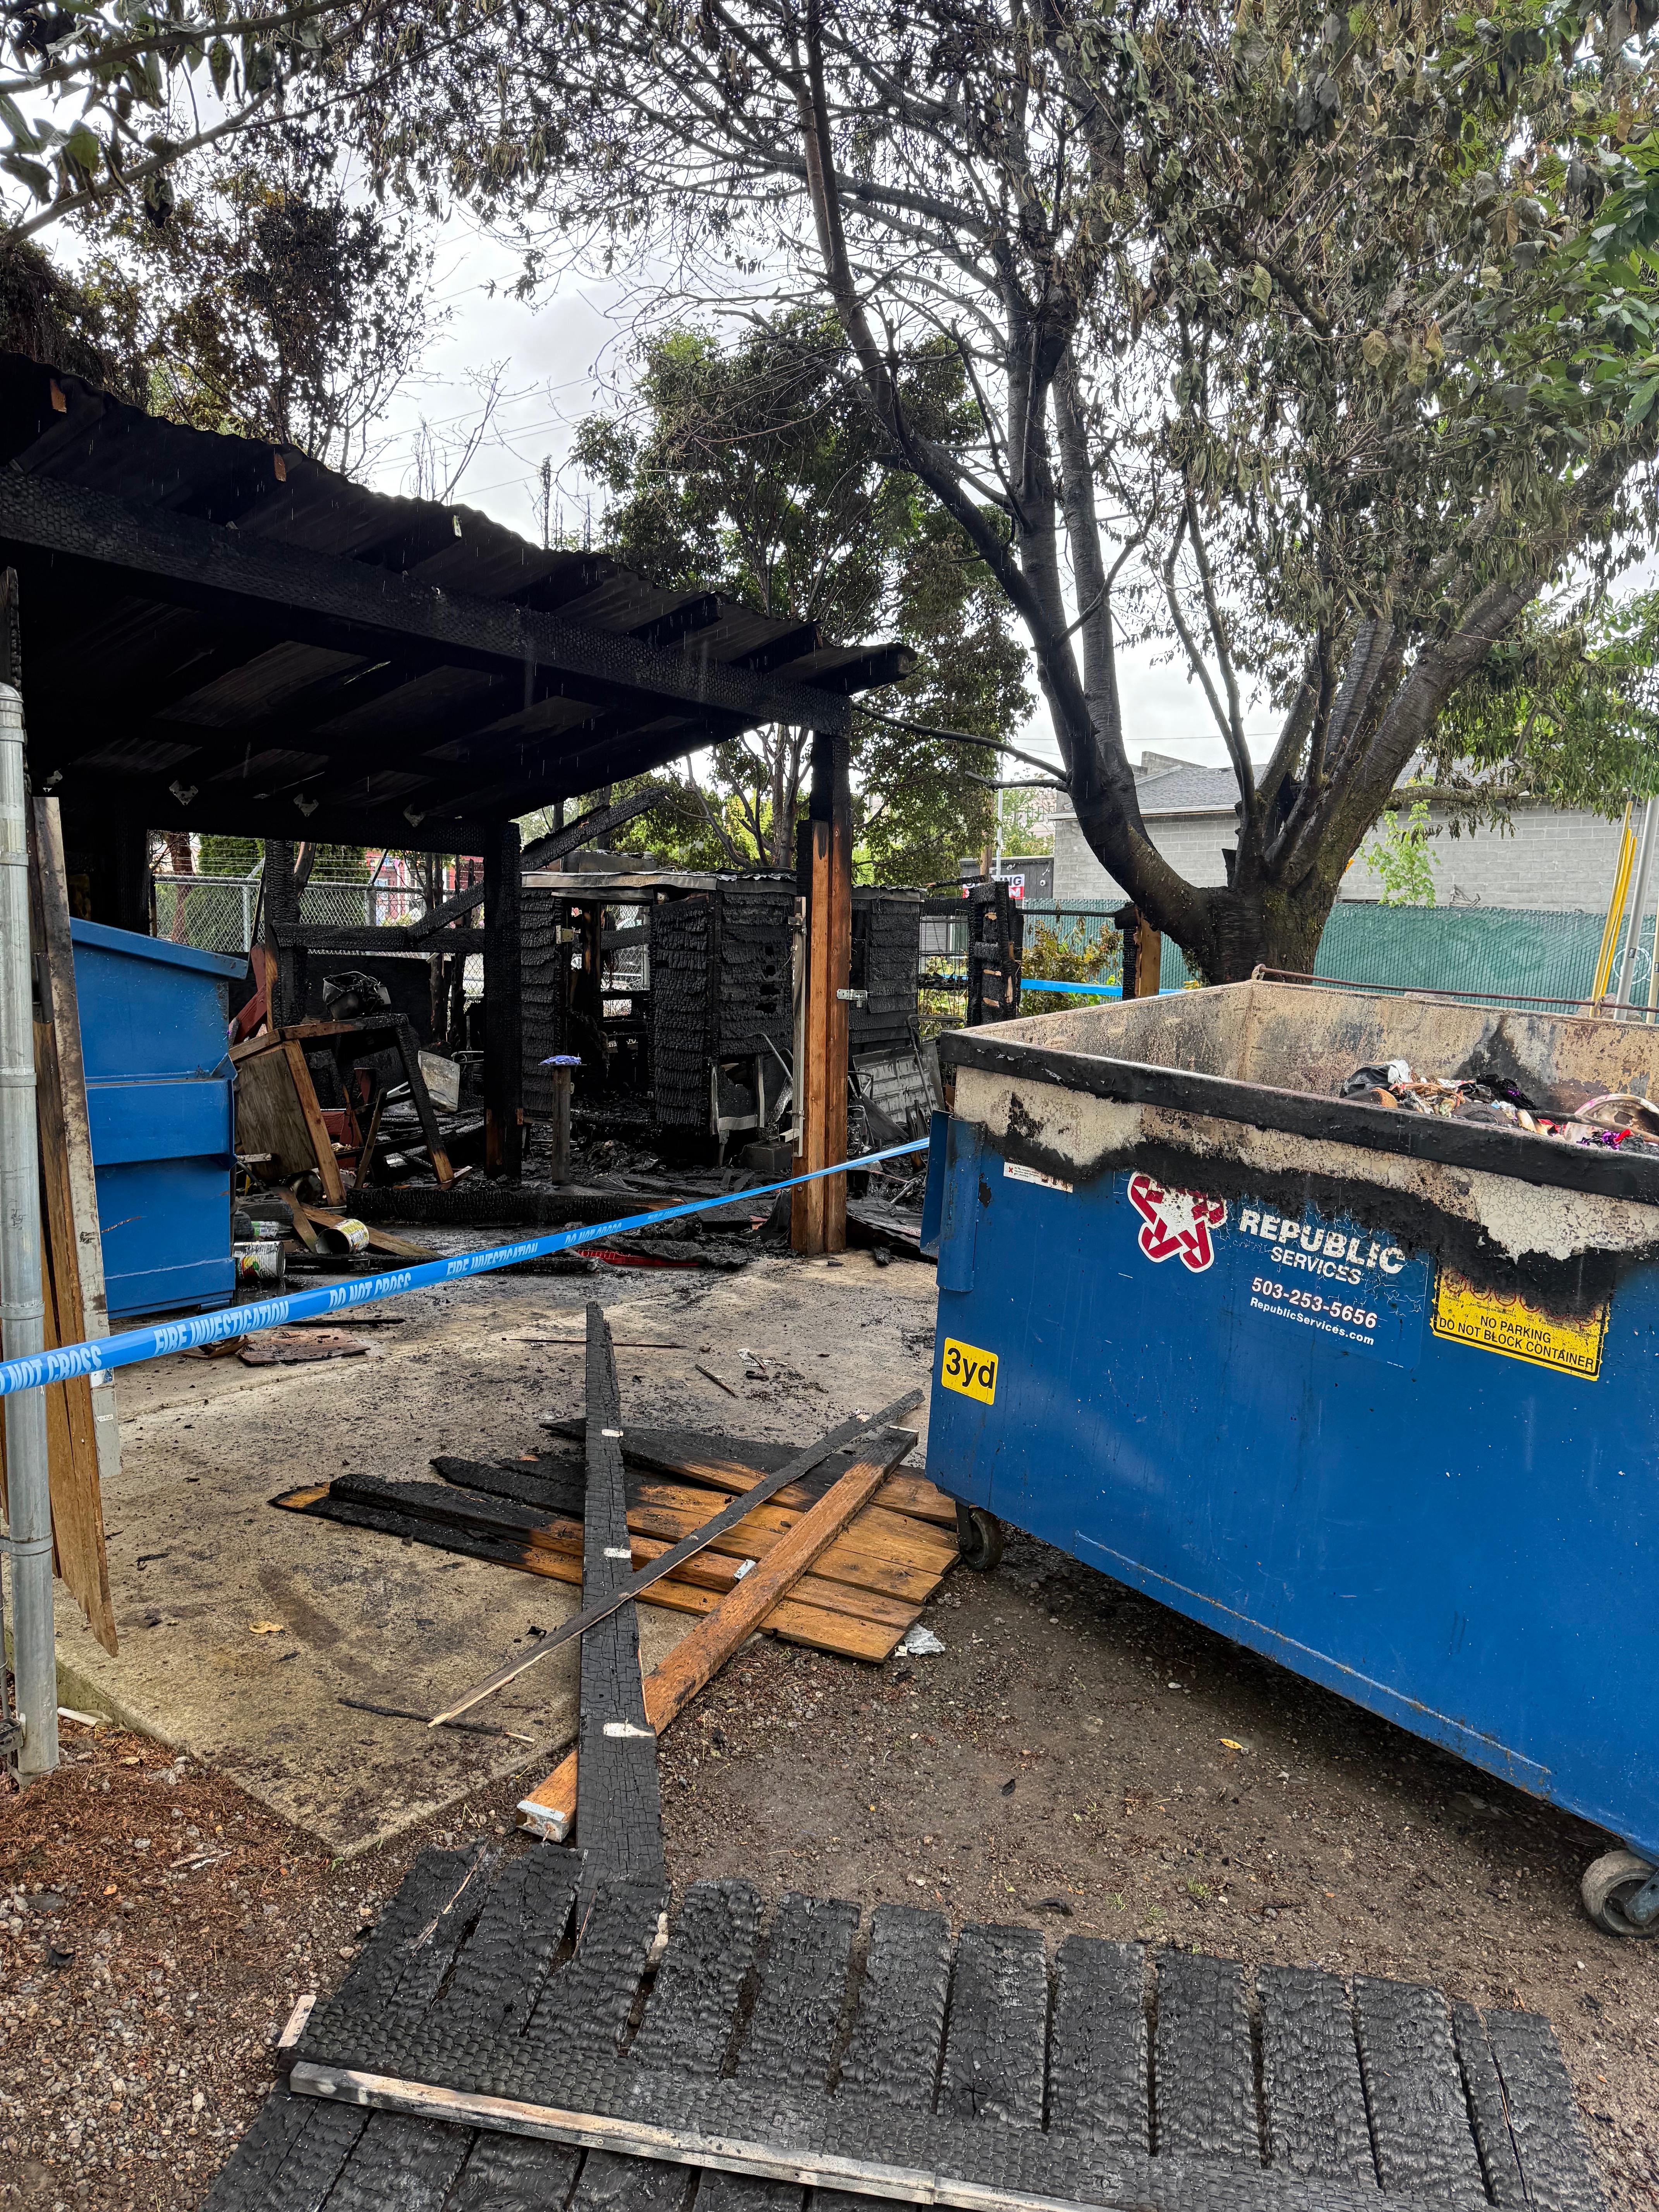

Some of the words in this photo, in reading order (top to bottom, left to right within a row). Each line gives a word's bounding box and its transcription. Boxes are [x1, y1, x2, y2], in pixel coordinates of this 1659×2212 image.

[1239, 1209, 1405, 1274] REPUBLIC
[1271, 1247, 1361, 1285] SERVICES
[329, 1287, 346, 1308] DO
[349, 1281, 373, 1302] NOT
[1252, 1277, 1377, 1328] 503-253-5656
[153, 1324, 187, 1355] FIRE
[190, 1300, 289, 1346] INVESTIGATION
[1250, 1297, 1374, 1345] RepublicServices.com
[1439, 1318, 1454, 1330] DO
[1458, 1323, 1480, 1338] NOT
[1484, 1331, 1522, 1350] BLOCK
[1527, 1341, 1594, 1369] CONTAINER
[1481, 1316, 1496, 1328] NO
[1501, 1321, 1551, 1343] PARKING
[6, 1358, 43, 1394] NOT
[46, 1345, 101, 1383] CROSS
[946, 1348, 995, 1389] 3yd
